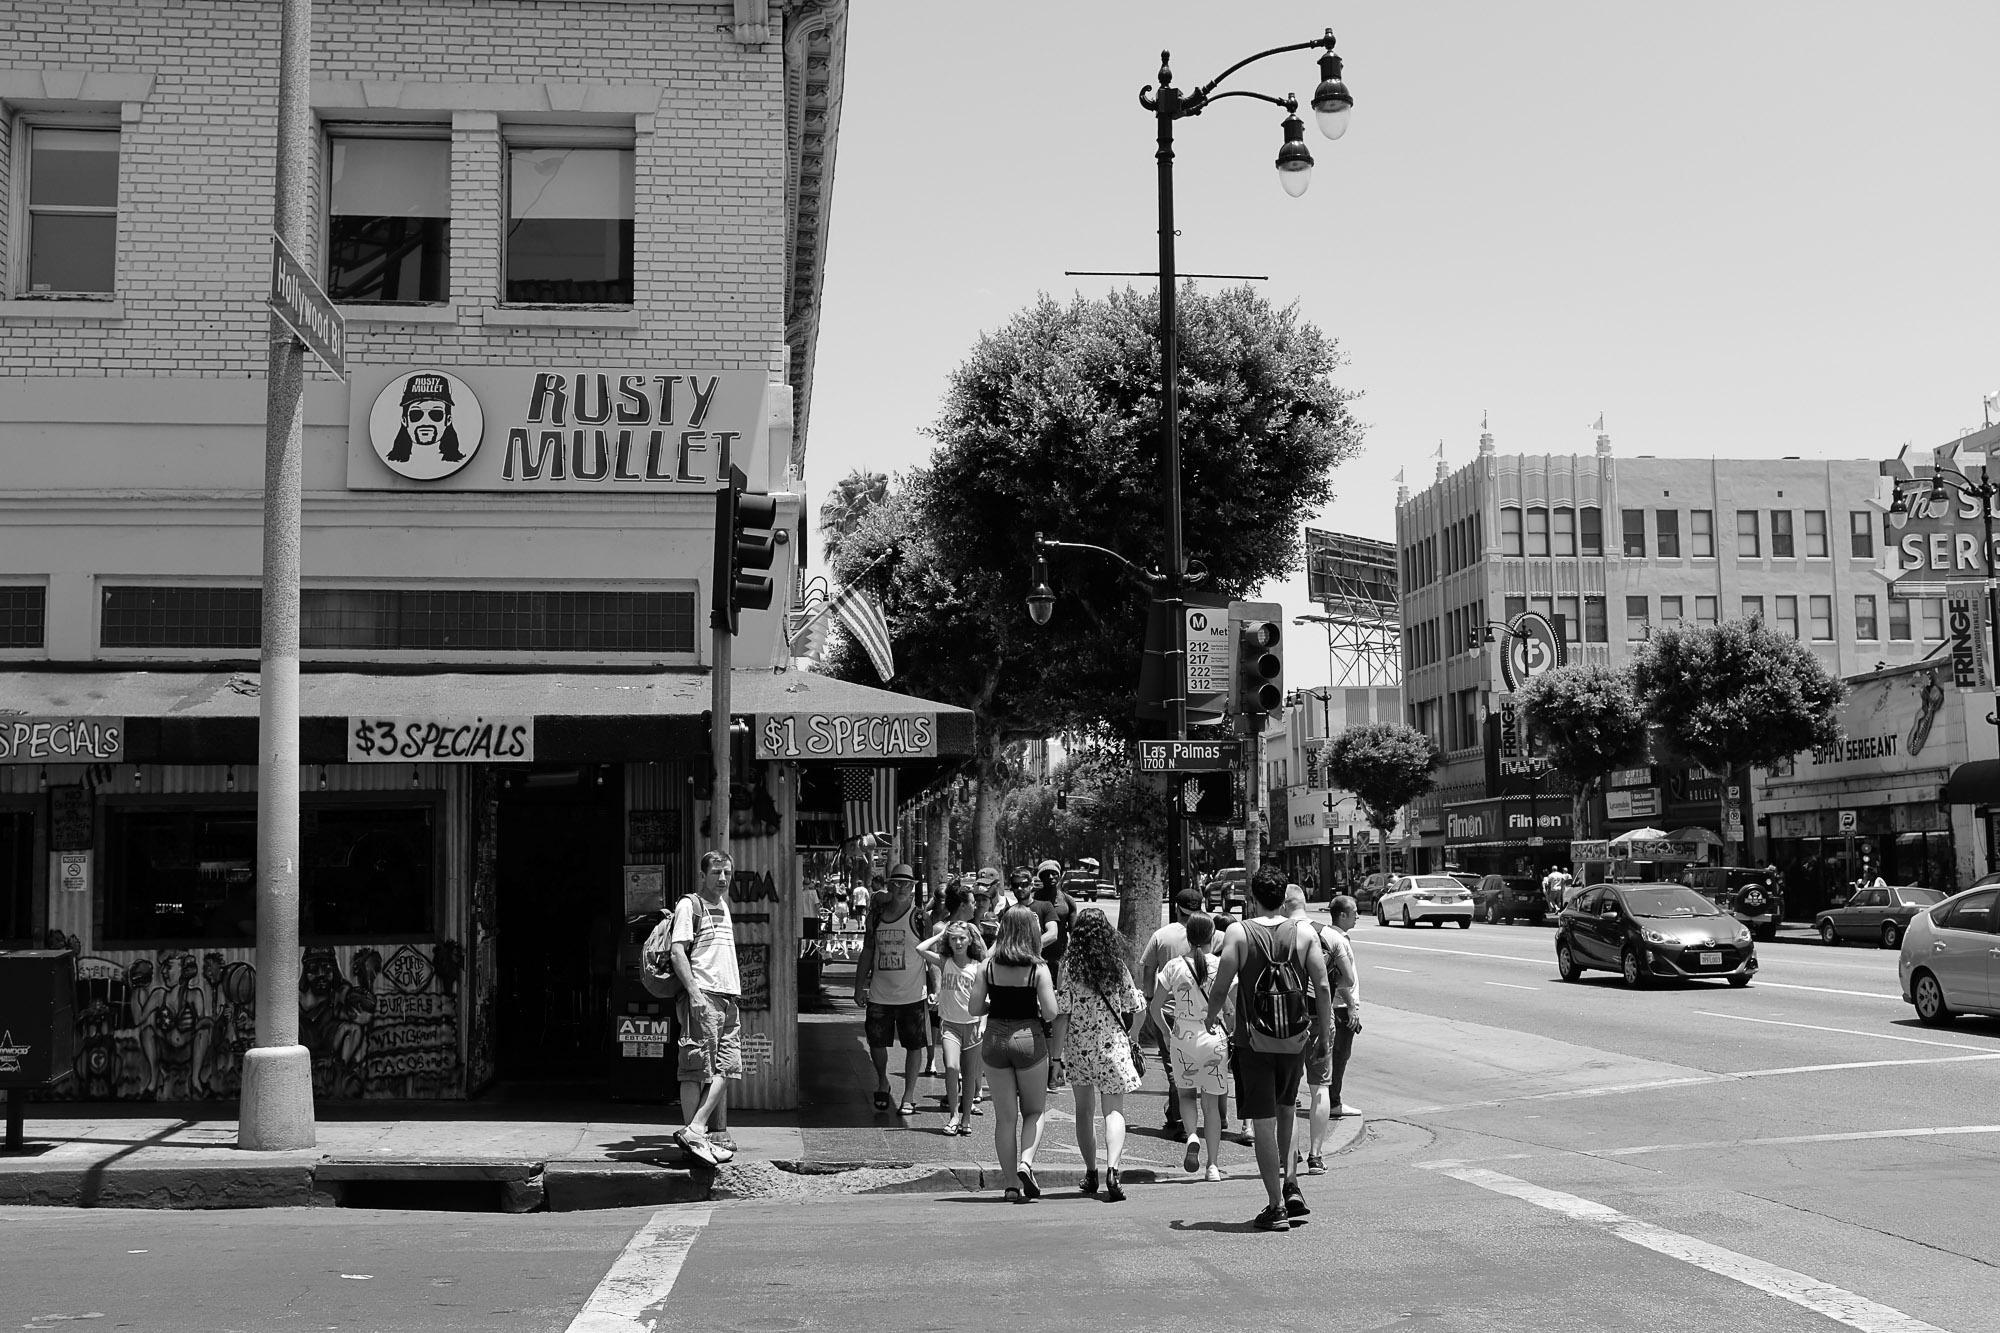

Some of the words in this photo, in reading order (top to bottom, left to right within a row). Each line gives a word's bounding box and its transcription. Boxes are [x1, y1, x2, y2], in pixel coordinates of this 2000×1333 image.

[278, 256, 329, 345] Hollywood
[331, 320, 341, 359] Bl
[411, 385, 443, 393] MULLET
[415, 377, 441, 385] RUSTY
[527, 372, 720, 428] RUSTY
[502, 427, 740, 483] MULLET
[1189, 642, 1209, 652] 212
[1949, 599, 1976, 687] FRINGE
[1189, 654, 1208, 664] 217
[1190, 667, 1210, 677] 222
[1191, 679, 1210, 690] 312
[355, 719, 398, 756] $3
[764, 716, 801, 756] $1
[1501, 703, 1517, 758] FRINGE
[1143, 743, 1166, 758] Las
[1173, 743, 1220, 758] Palmas
[1846, 734, 1897, 761] SERGEANT
[1143, 758, 1165, 769] 1700
[1168, 758, 1175, 769] N
[1228, 759, 1239, 769] Av
[1306, 747, 1319, 789] FRINGE
[395, 955, 424, 971] SPORTS
[379, 997, 432, 1014] BURGERS
[620, 1020, 667, 1034] ATM
[371, 1056, 424, 1073] TACOS
